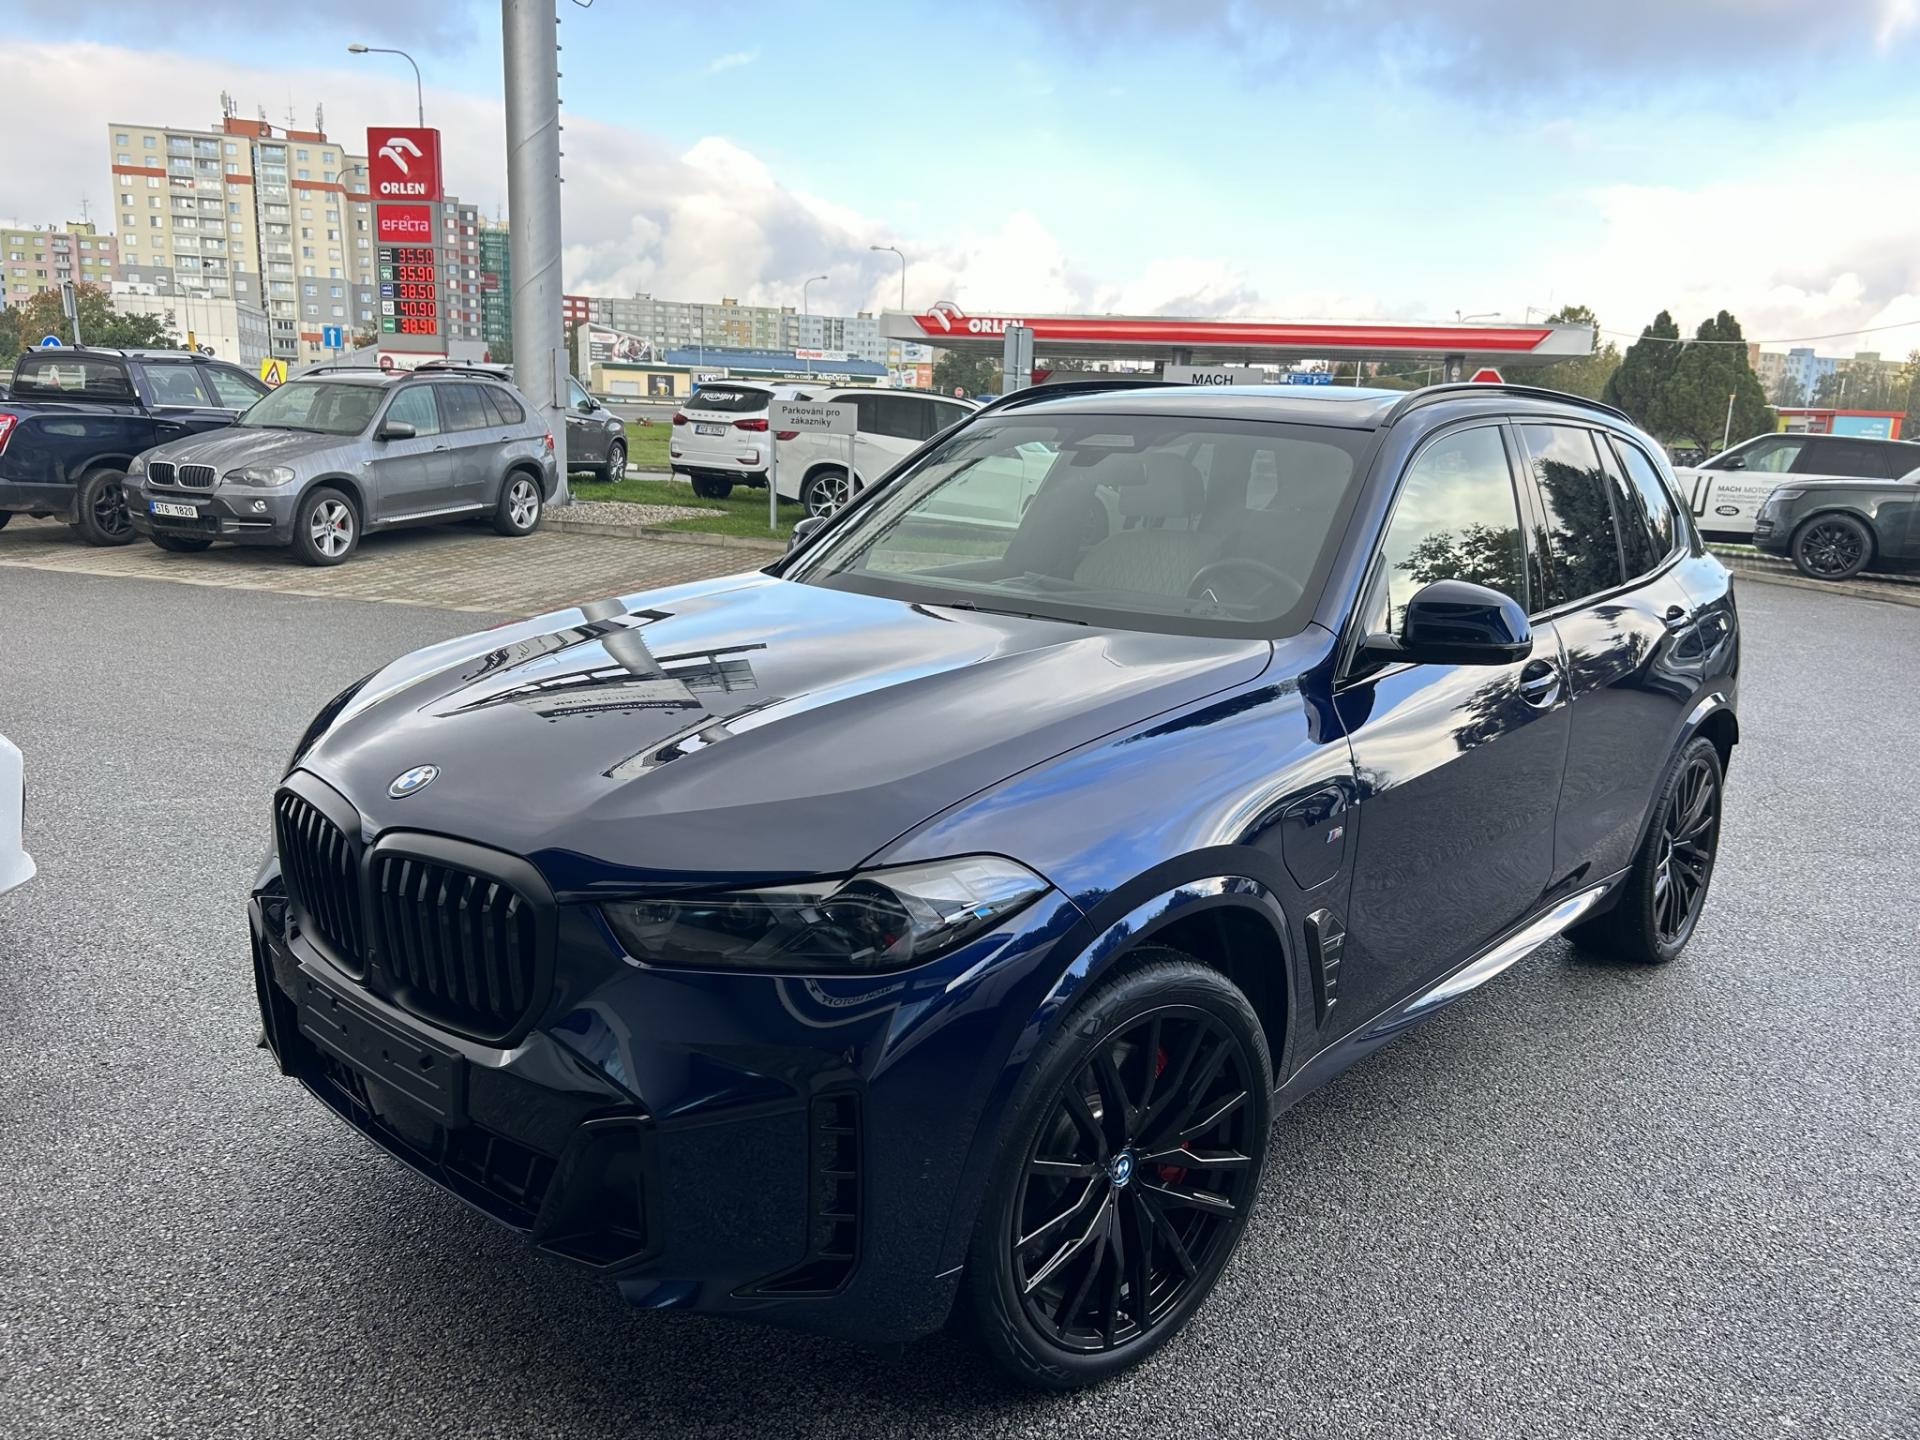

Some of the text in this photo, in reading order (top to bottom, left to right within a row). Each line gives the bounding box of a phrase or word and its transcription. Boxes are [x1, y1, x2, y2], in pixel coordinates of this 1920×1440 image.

[380, 182, 425, 194] ORLEN
[399, 248, 433, 264] 35.50
[400, 266, 434, 281] 35.90
[400, 284, 434, 299] 38.50
[400, 302, 435, 317] 40.90
[401, 318, 436, 334] 38.90
[1192, 373, 1233, 385] MACH
[700, 392, 734, 401] TRIUMPH
[826, 409, 840, 417] pro
[156, 503, 194, 516] 5T6 1820
